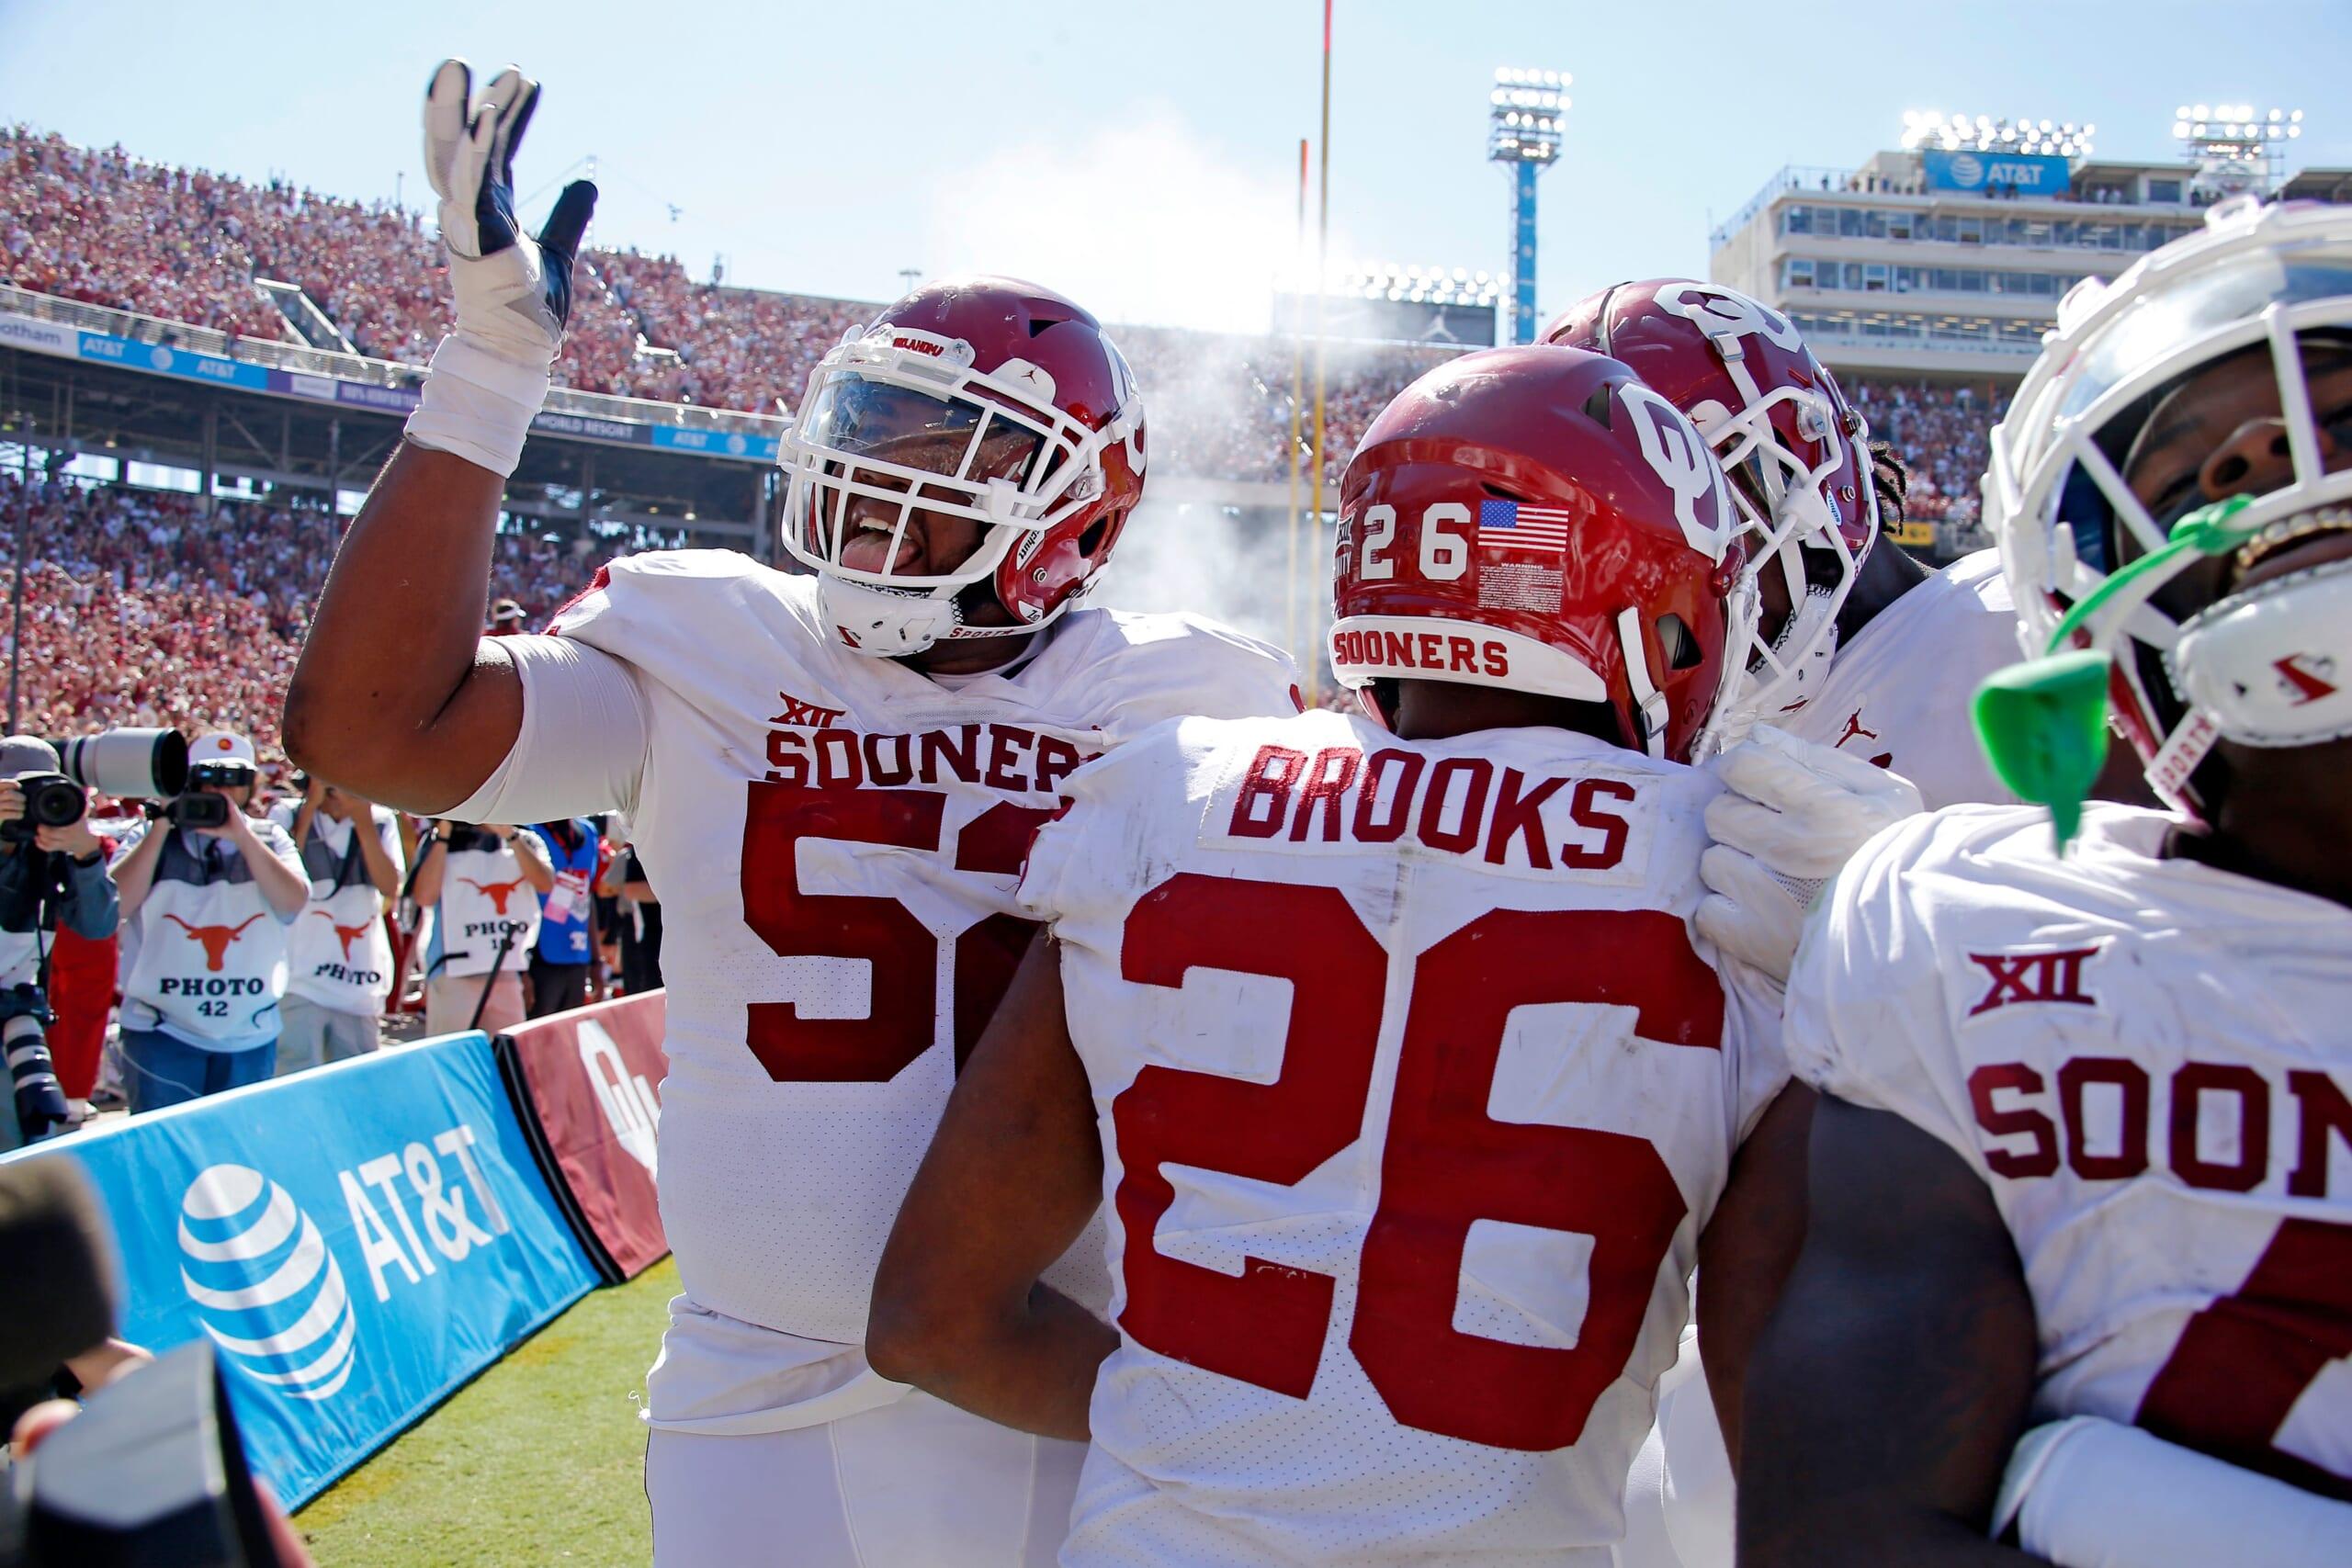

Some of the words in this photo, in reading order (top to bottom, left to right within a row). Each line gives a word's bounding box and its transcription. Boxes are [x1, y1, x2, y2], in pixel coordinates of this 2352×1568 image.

[1986, 163, 2044, 185] AT&T
[82, 336, 126, 357] AT&T
[197, 356, 237, 380] AT&T
[584, 418, 635, 439] RESORT
[672, 430, 708, 448] AT&T
[1361, 502, 1472, 581] 26
[1334, 632, 1509, 677] SOONERS
[768, 692, 846, 728] XII
[764, 723, 1104, 792] SOONER
[1228, 744, 1636, 871] BROOKS
[160, 978, 264, 996] PHOTO
[1968, 946, 2100, 1018] XII
[198, 1001, 229, 1017] 42
[1113, 871, 1725, 1452] 26
[339, 1124, 511, 1303] AT&T
